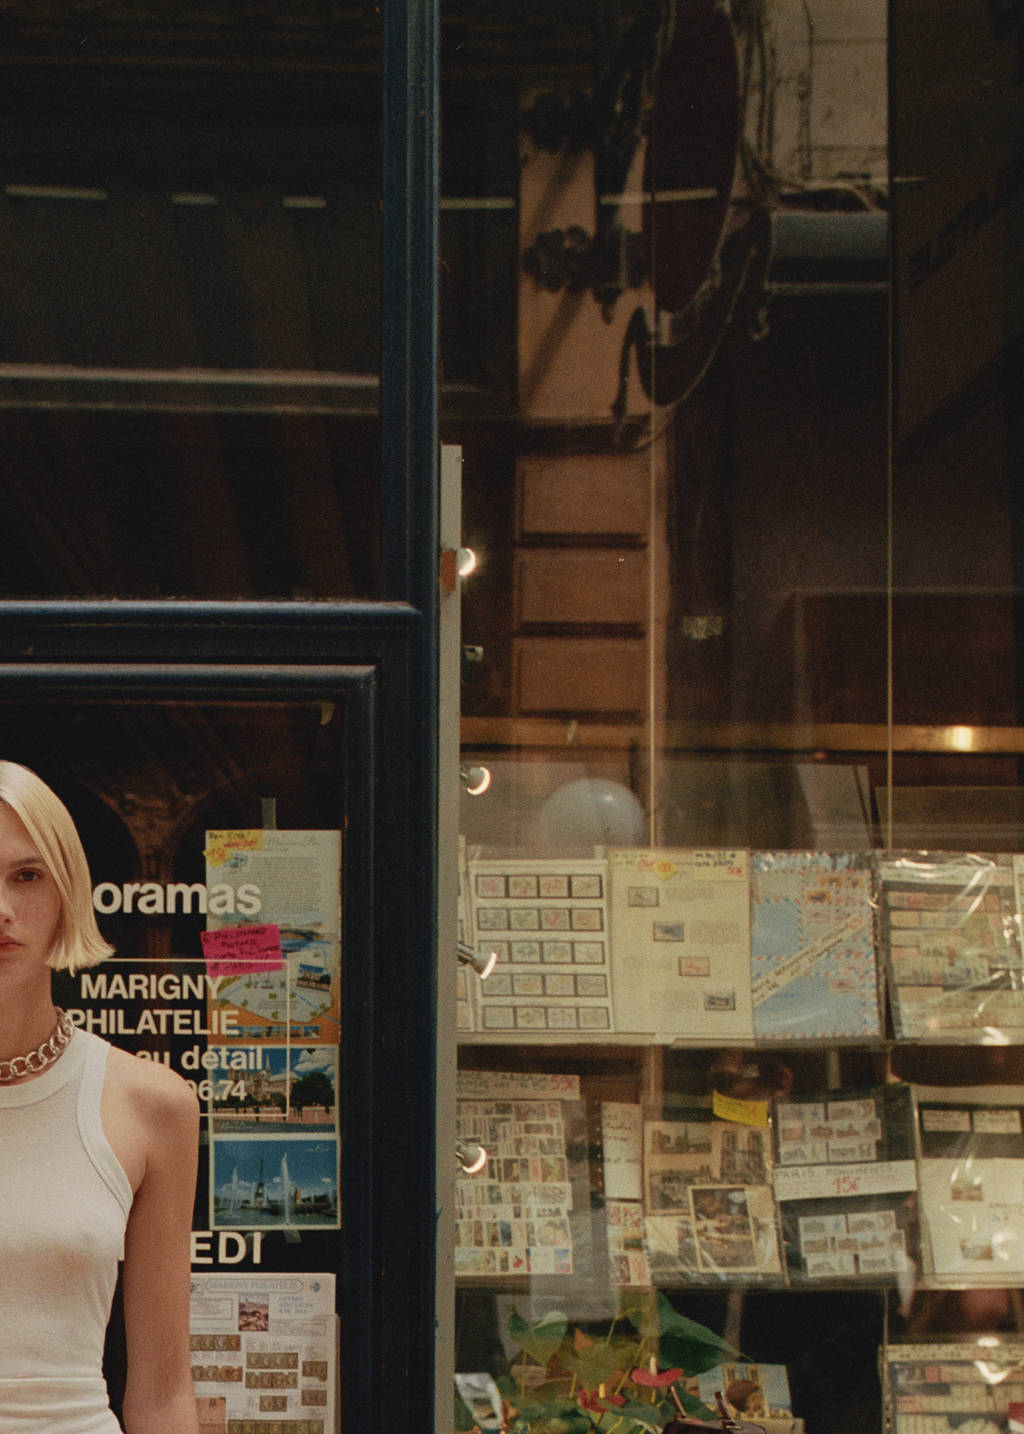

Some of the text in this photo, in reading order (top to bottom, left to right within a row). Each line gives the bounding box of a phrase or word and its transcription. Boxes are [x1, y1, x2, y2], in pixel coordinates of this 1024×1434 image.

[92, 882, 263, 916] oramas
[80, 974, 224, 1000] MARIGNY
[69, 1008, 240, 1036] PHILATELIE
[190, 1231, 262, 1264] EDI
